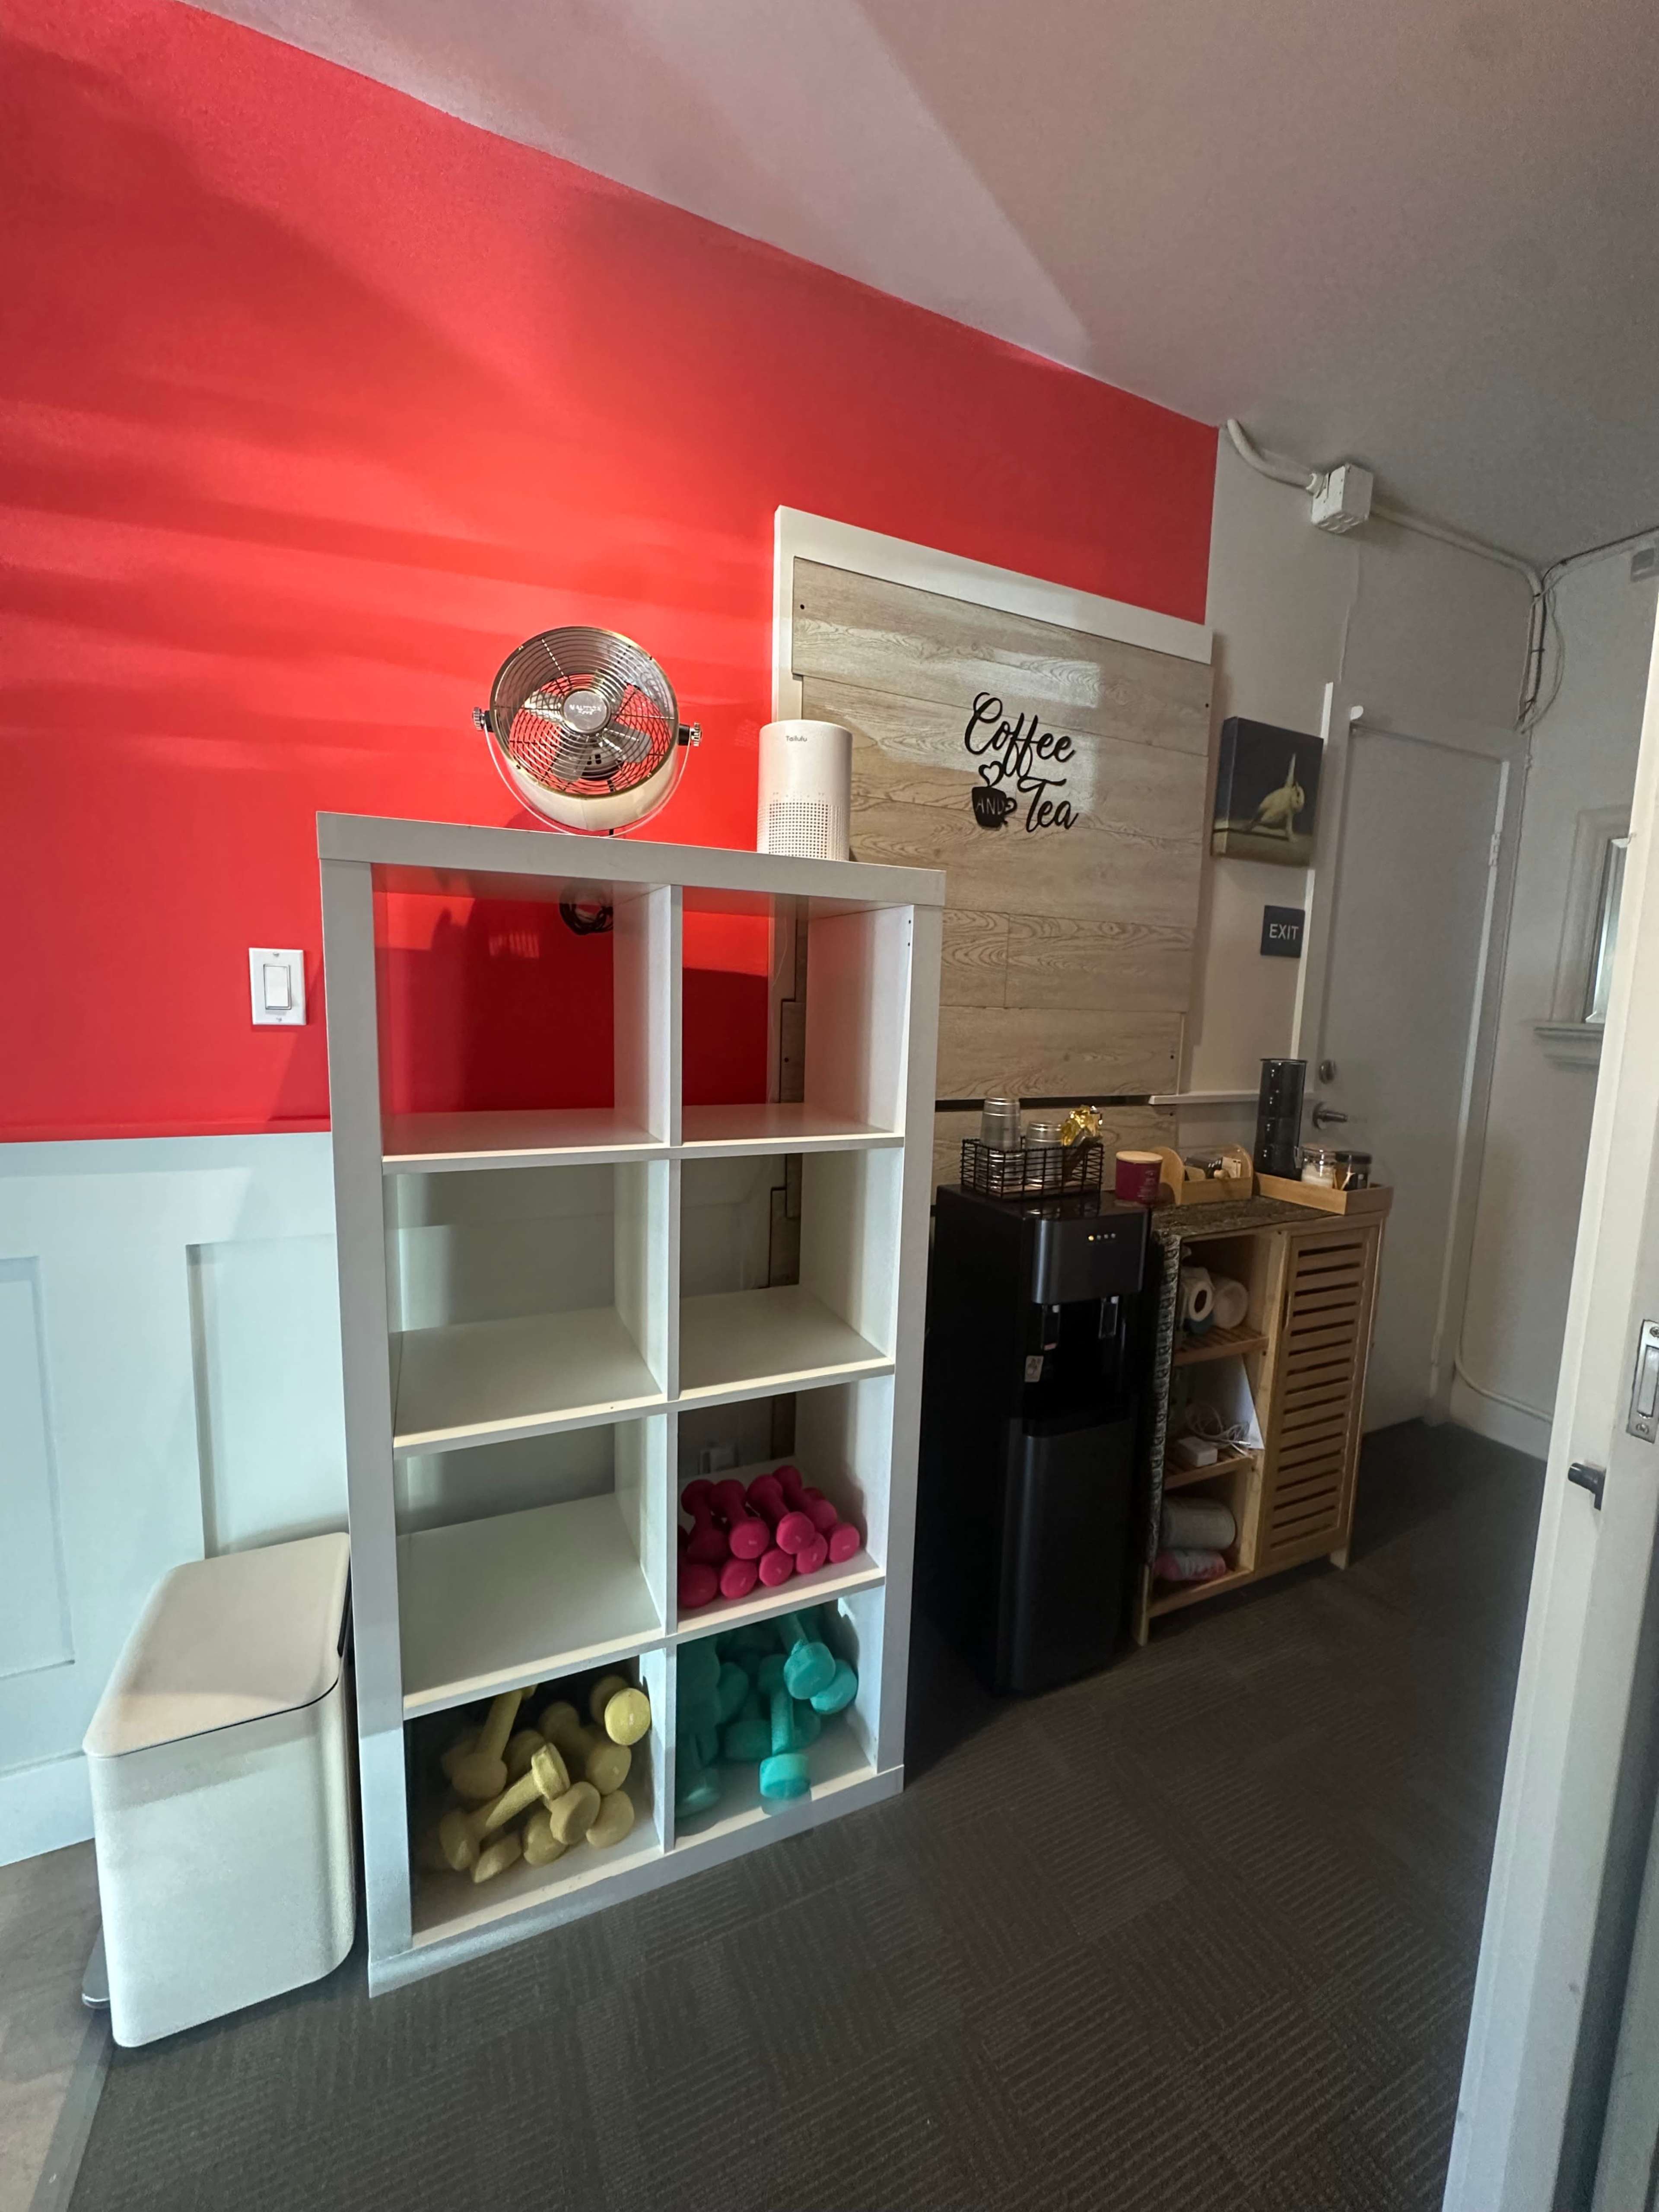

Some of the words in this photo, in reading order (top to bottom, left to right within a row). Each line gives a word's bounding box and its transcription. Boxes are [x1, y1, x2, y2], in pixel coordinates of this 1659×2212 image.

[964, 692, 1077, 777] Coffee
[976, 797, 1005, 815] AND
[1017, 776, 1079, 833] Tea
[1269, 923, 1299, 940] EXIT
